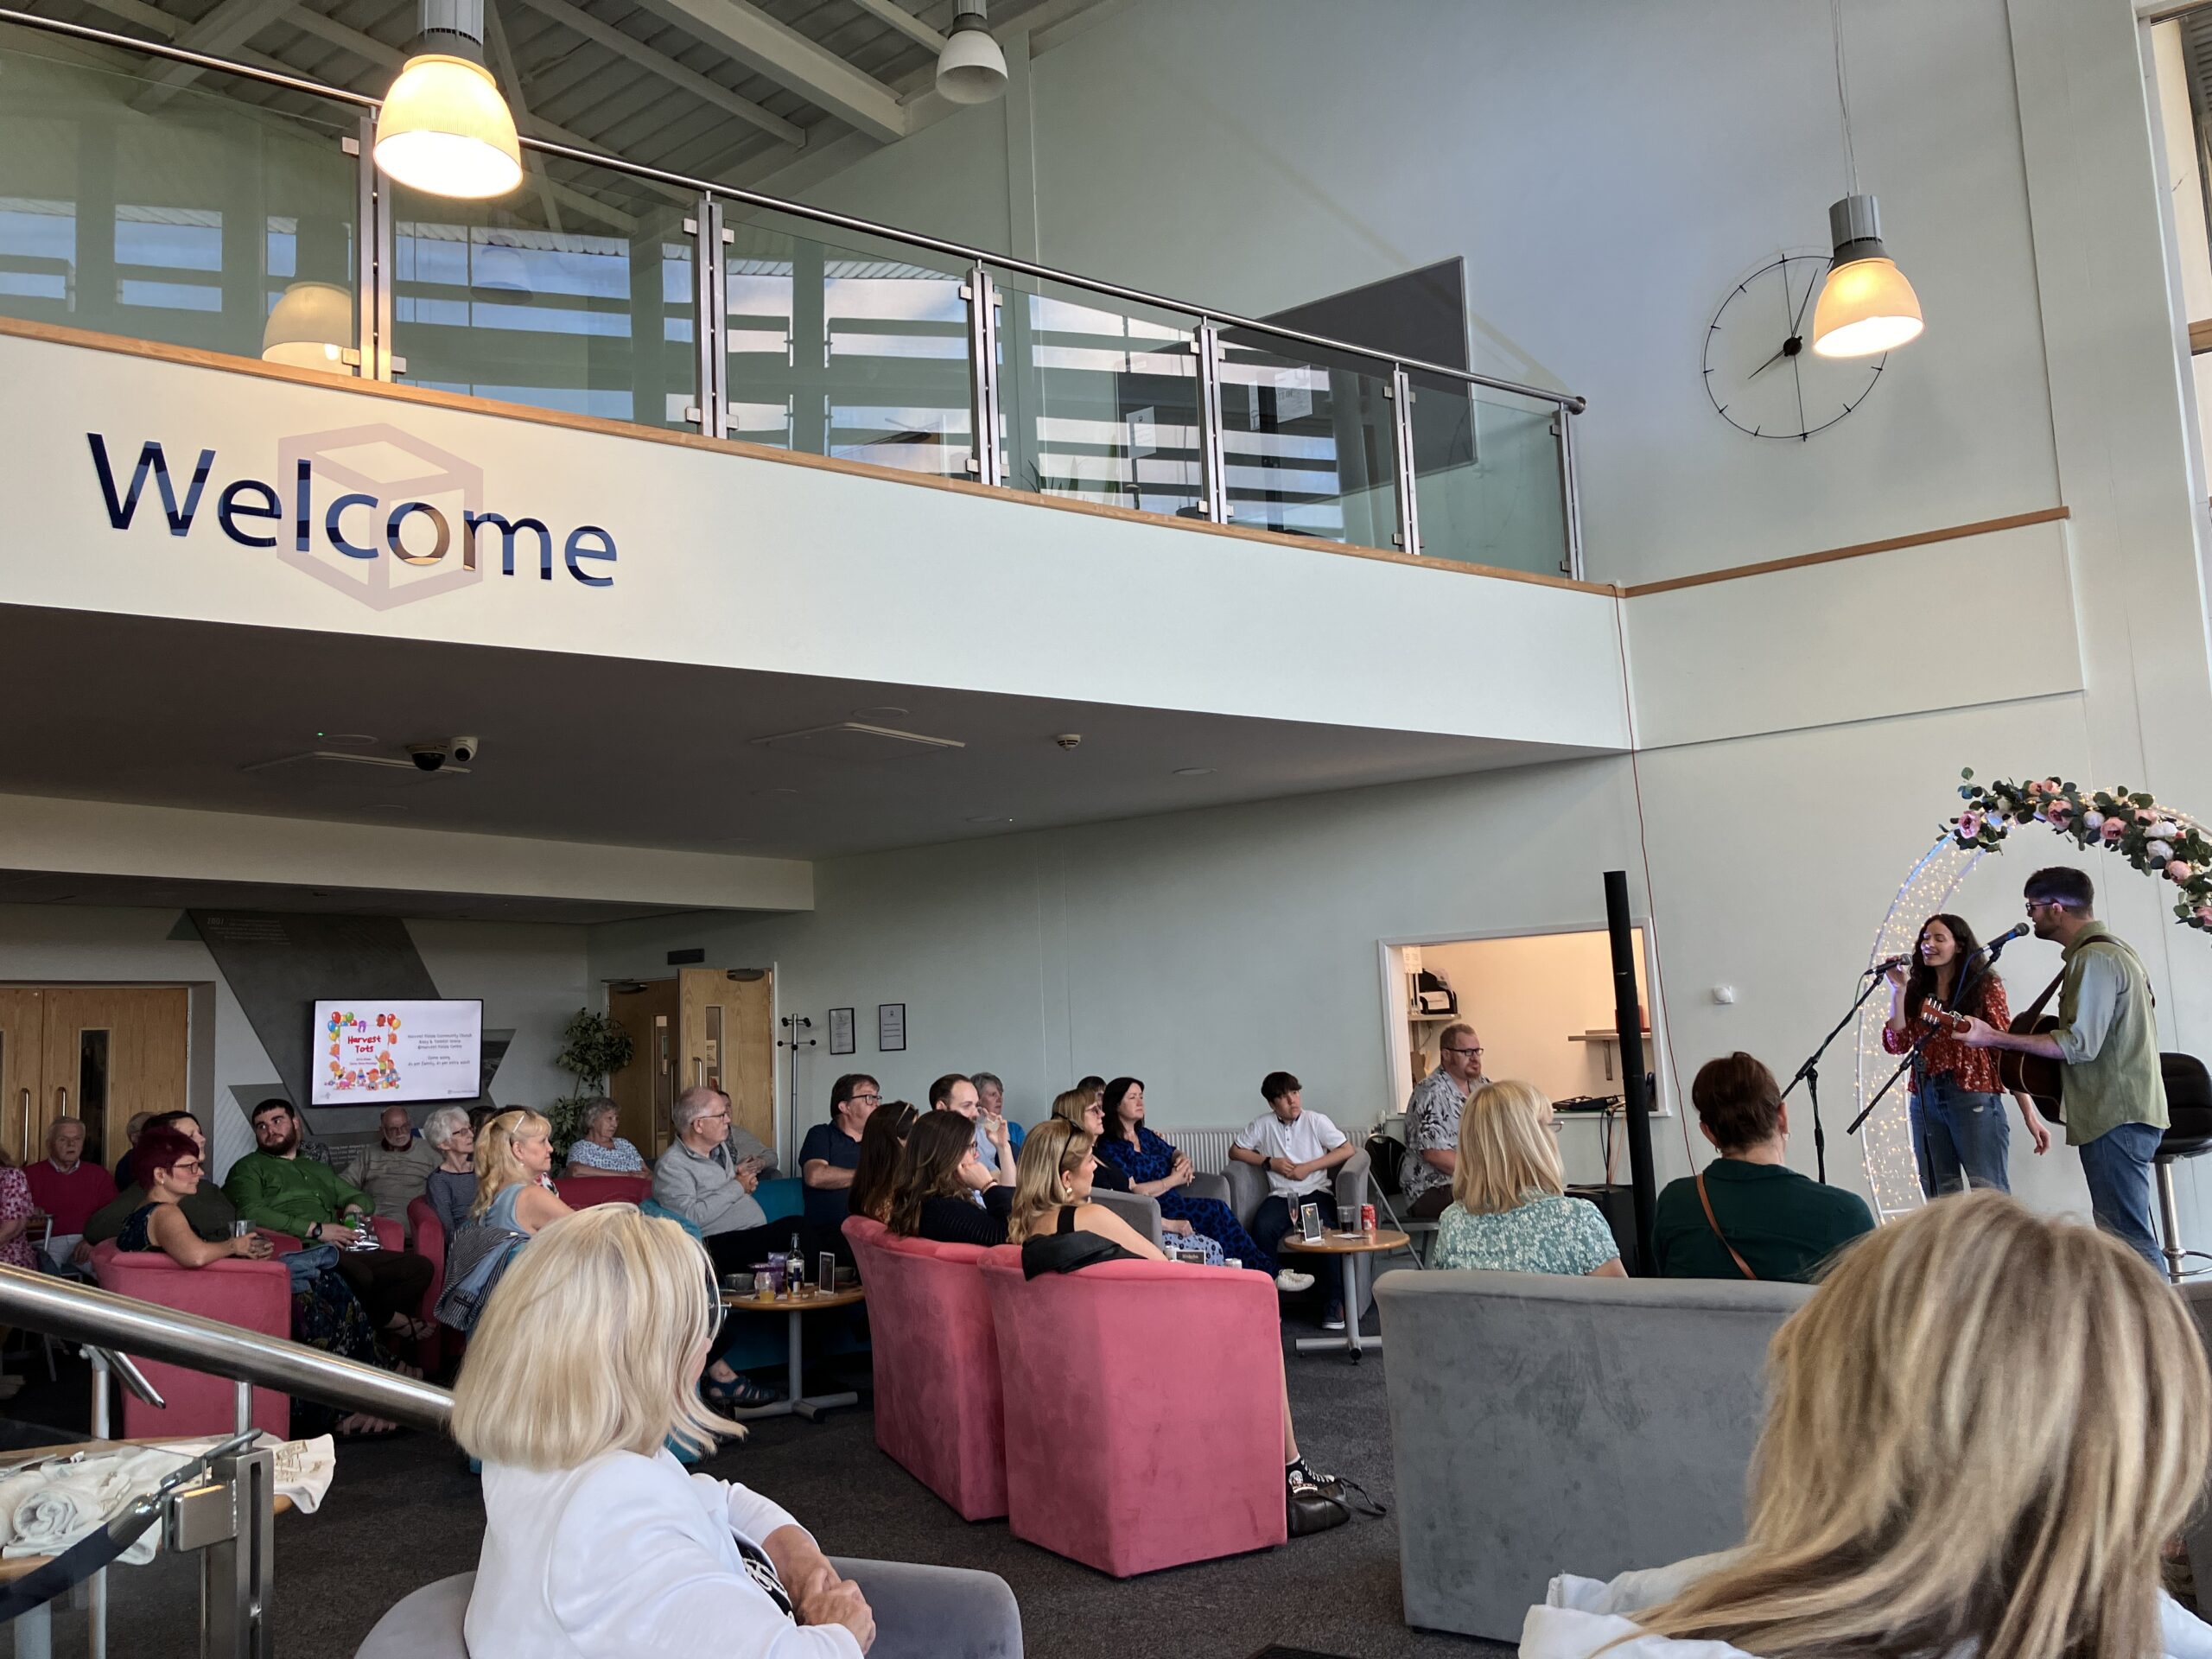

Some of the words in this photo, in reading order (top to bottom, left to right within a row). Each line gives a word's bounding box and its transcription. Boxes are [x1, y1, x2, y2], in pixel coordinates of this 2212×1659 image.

[86, 432, 618, 588] Welcome
[347, 1035, 381, 1045] Harvest
[355, 1045, 374, 1053] Tots
